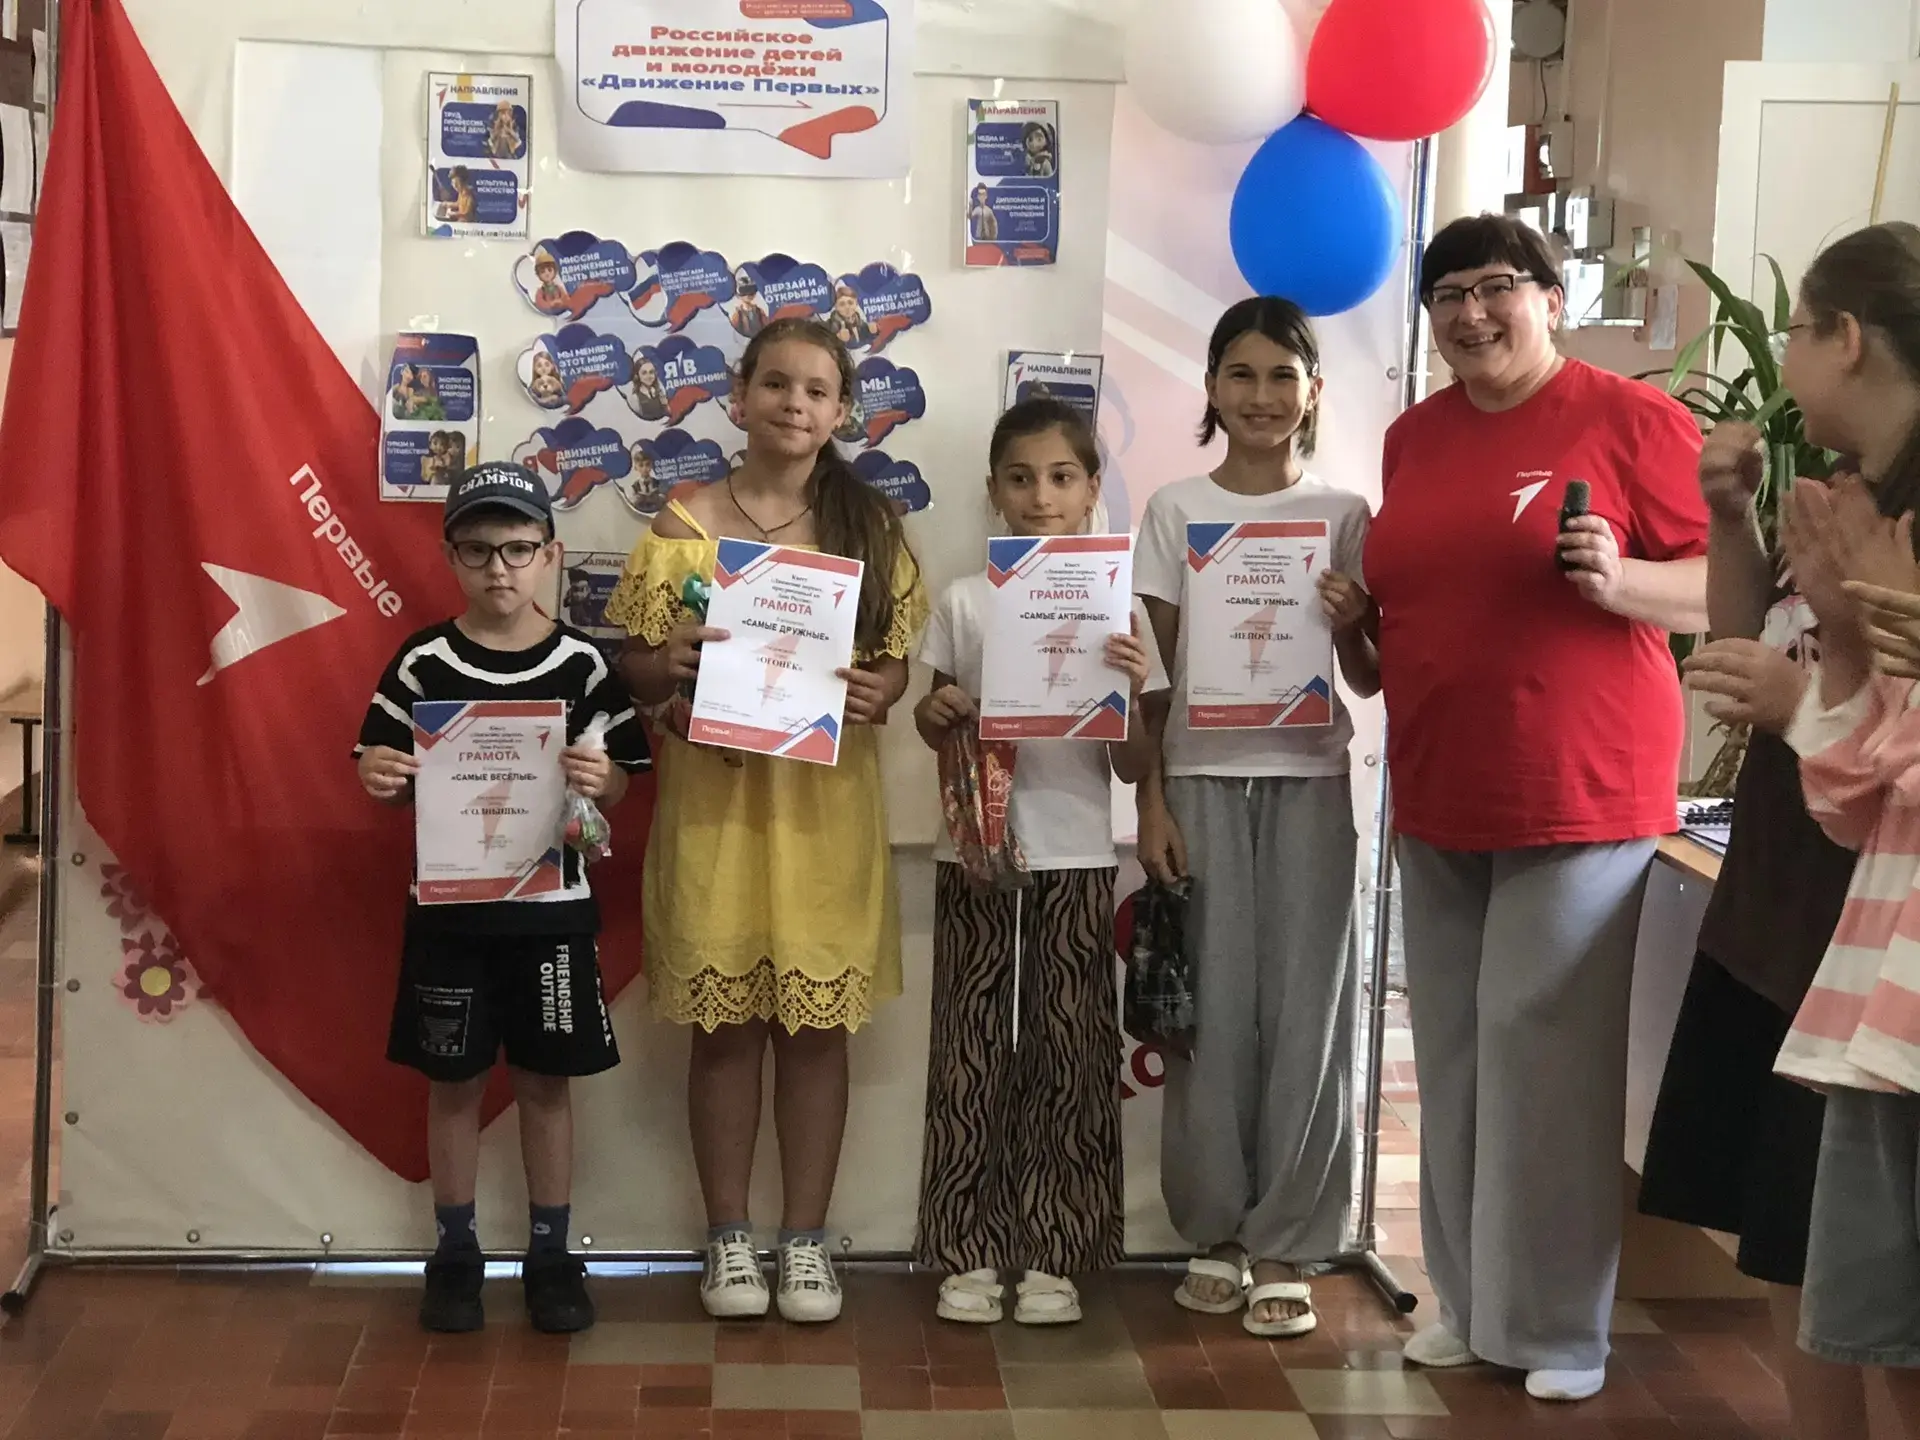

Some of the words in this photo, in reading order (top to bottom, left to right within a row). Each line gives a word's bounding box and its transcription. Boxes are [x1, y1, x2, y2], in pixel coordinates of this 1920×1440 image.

[651, 26, 813, 43] Российское
[612, 44, 756, 60] движение
[763, 48, 842, 61] детей
[647, 62, 662, 72] и
[671, 62, 816, 77] молодёжи
[450, 85, 518, 96] НАПРАВЛЕНИЯ
[581, 74, 745, 91] «Движение
[753, 78, 880, 95] Первых»
[559, 252, 600, 265] МИССИЯ
[561, 260, 614, 275] ДВИЖЕНИЯ
[562, 272, 588, 284] БЫТЬ
[590, 266, 629, 279] ВМЕСТЕ!
[764, 279, 807, 295] ДЕРЗАЙ
[808, 278, 816, 287] И
[765, 285, 828, 303] ОТКРЫВАЙ!
[863, 298, 869, 306] Я
[869, 294, 898, 305] НАЙДУ
[864, 297, 924, 314] ПРИЗВАНИЕ!
[557, 350, 574, 361] МЫ
[575, 344, 614, 357] МЕНЯЕМ
[559, 356, 586, 367] ЭТОТ
[587, 355, 607, 366] МИР
[560, 369, 567, 378] К
[569, 361, 619, 377] ЛУЧШЕМУ!
[663, 362, 678, 379] Я
[683, 358, 698, 374] В
[1027, 365, 1092, 376] НАПРАВЛЕНИЯ
[665, 371, 728, 389] ДВИЖЕНИИ!
[556, 443, 620, 462] ДВИЖЕНИЕ
[556, 456, 603, 471] ПЕРВЫХ
[458, 473, 534, 495] CHAMPION
[868, 472, 916, 487] КРЫВАЙ
[289, 463, 403, 617] Первые
[1226, 574, 1285, 585] ГРАМОТА
[1029, 589, 1089, 600] ГРАМОТА
[1225, 597, 1261, 606] «САМЫЕ
[1263, 597, 1299, 606] УМНЫЕ»
[753, 597, 813, 616] ГРАМОТА
[1020, 612, 1056, 620] «САМЫЕ
[1058, 612, 1110, 621] АКТИВНЫЕ»
[742, 618, 777, 631] «САМЫЕ
[779, 625, 829, 641] ДРУЖНЫЕ»
[1229, 632, 1293, 641] «НЕПОСЕДЫ»
[1037, 647, 1087, 655] «ФИАЛКА»
[458, 751, 520, 762] ГРАМОТА
[451, 773, 487, 781] «САМЫЕ
[490, 772, 538, 781] ВЕСЁЛЫЕ»
[540, 962, 556, 1032] OUTRIDE
[556, 944, 573, 1034] FRIENDSHIP
